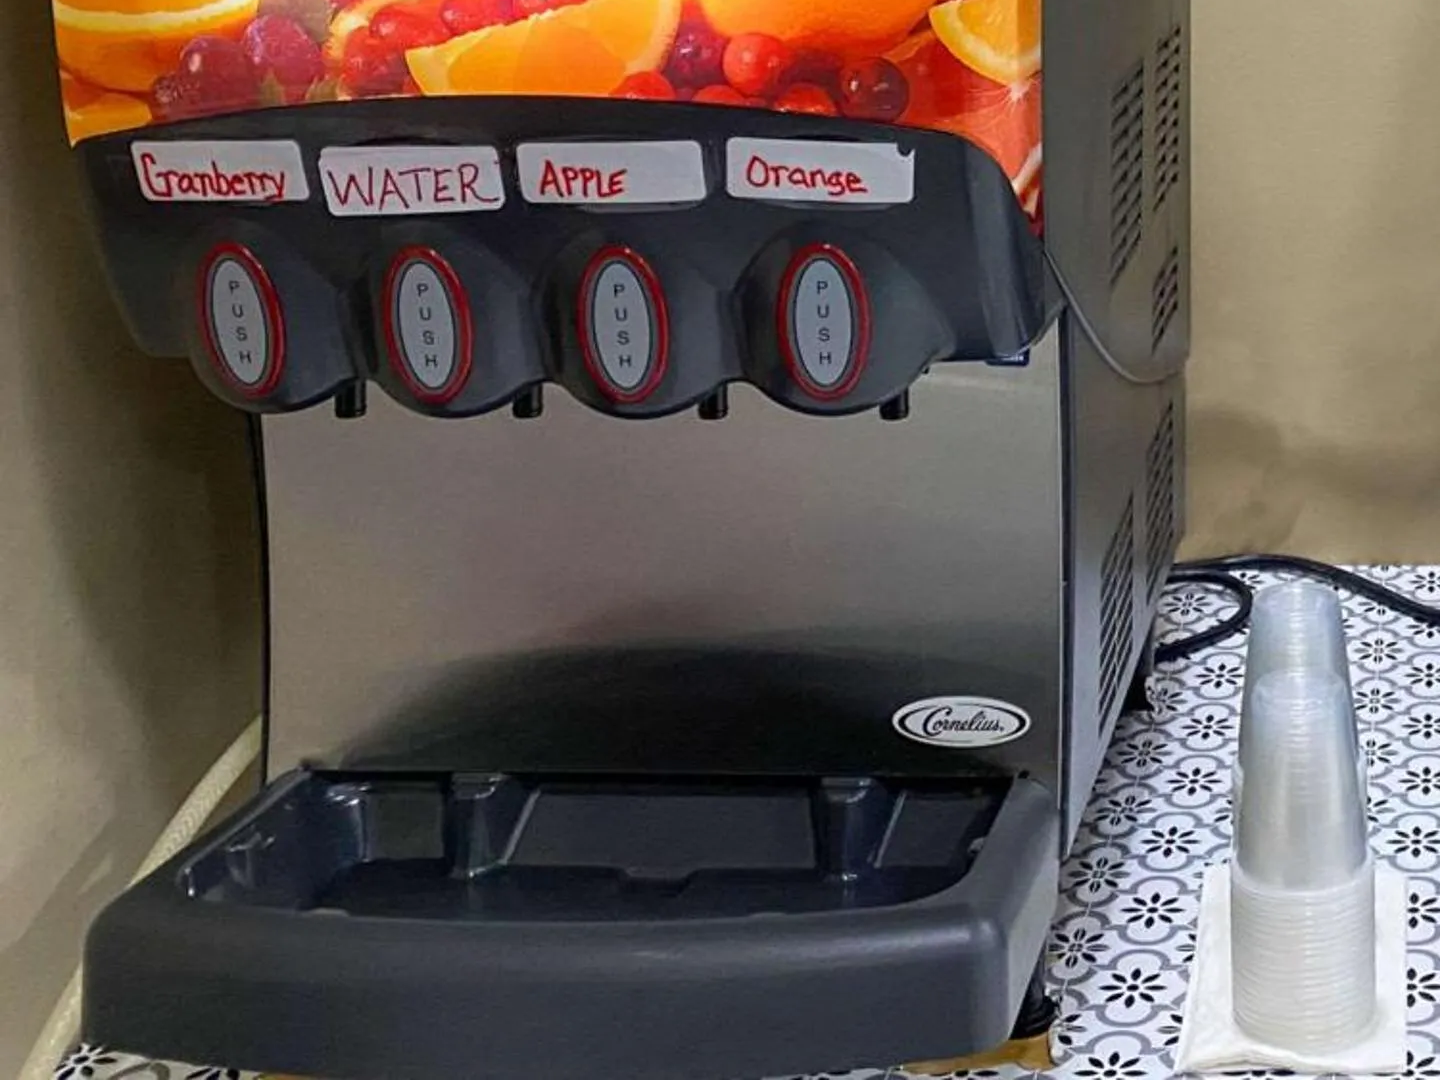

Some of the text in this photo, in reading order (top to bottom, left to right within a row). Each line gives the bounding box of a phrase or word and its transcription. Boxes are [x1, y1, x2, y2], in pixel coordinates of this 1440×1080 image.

[327, 163, 500, 211] WATER
[539, 159, 628, 198] APPLE
[746, 155, 868, 197] Orange
[227, 279, 252, 365] PUSH
[417, 282, 439, 368] PUSH
[613, 283, 633, 369] PUSH
[816, 280, 833, 366] PUSH
